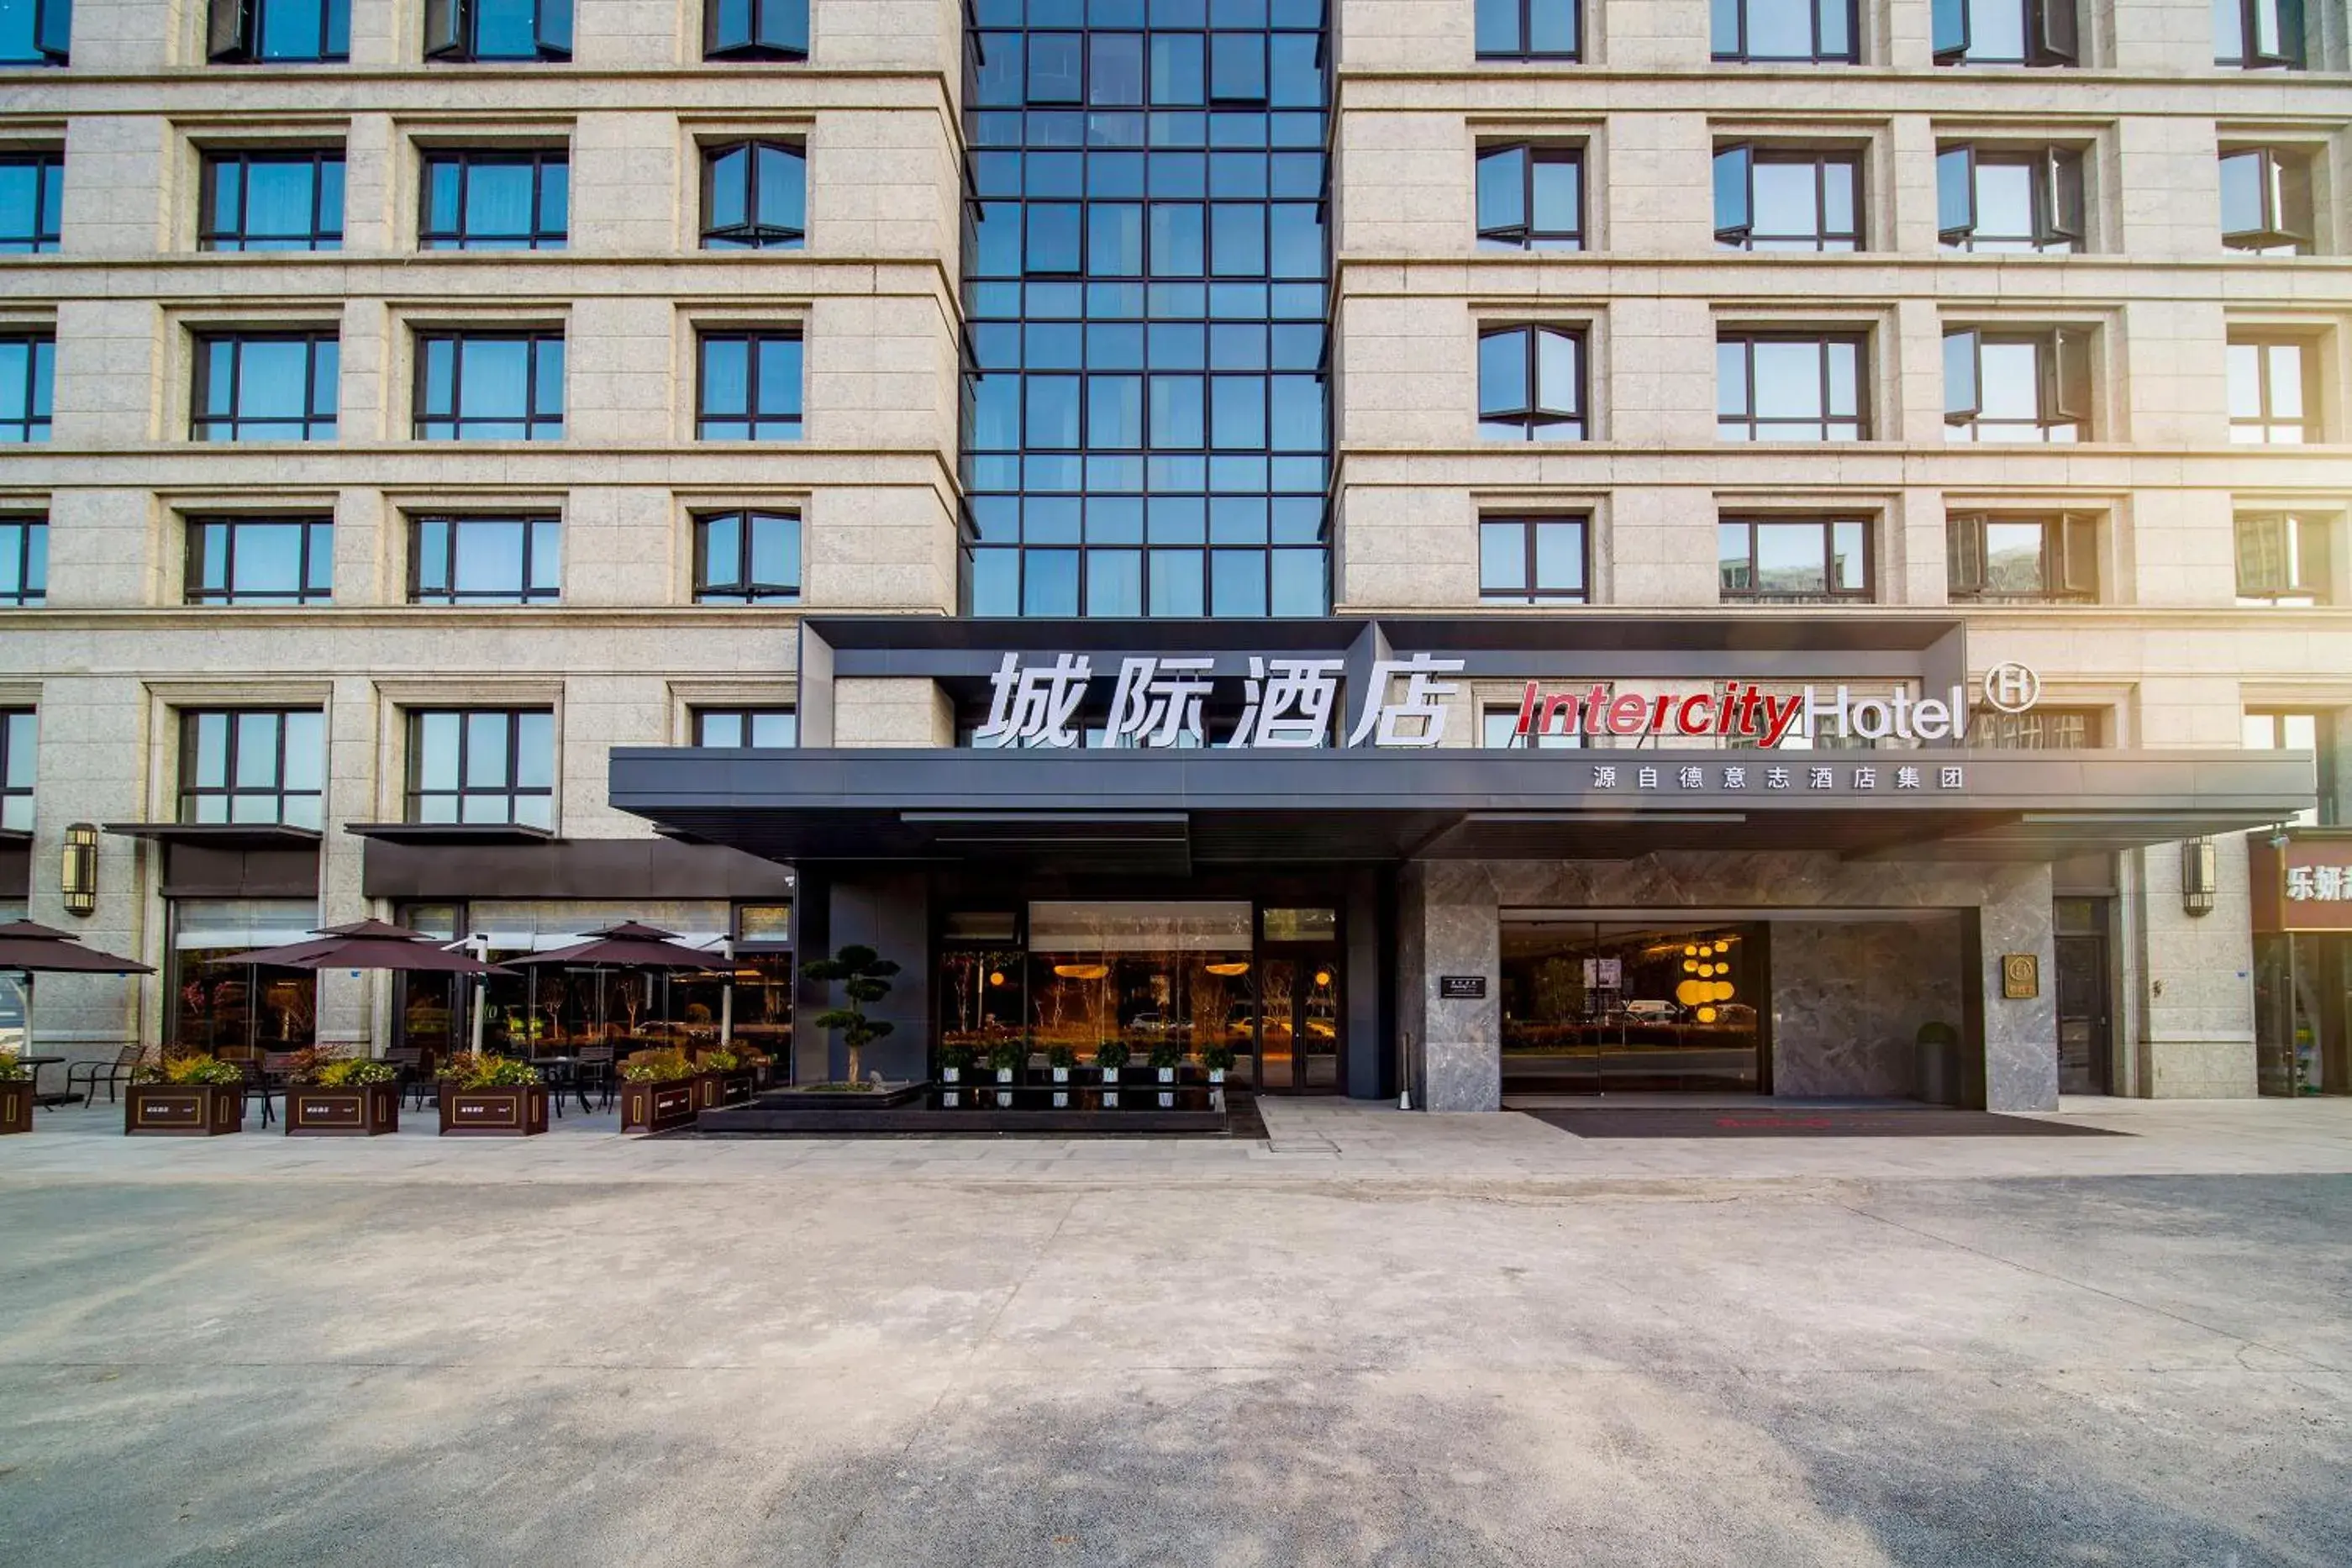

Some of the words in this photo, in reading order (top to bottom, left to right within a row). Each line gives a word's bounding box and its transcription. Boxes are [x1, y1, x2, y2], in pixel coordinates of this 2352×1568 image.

[977, 652, 1465, 748] 城际酒店
[1594, 766, 1962, 789] 源自德意志酒店集团
